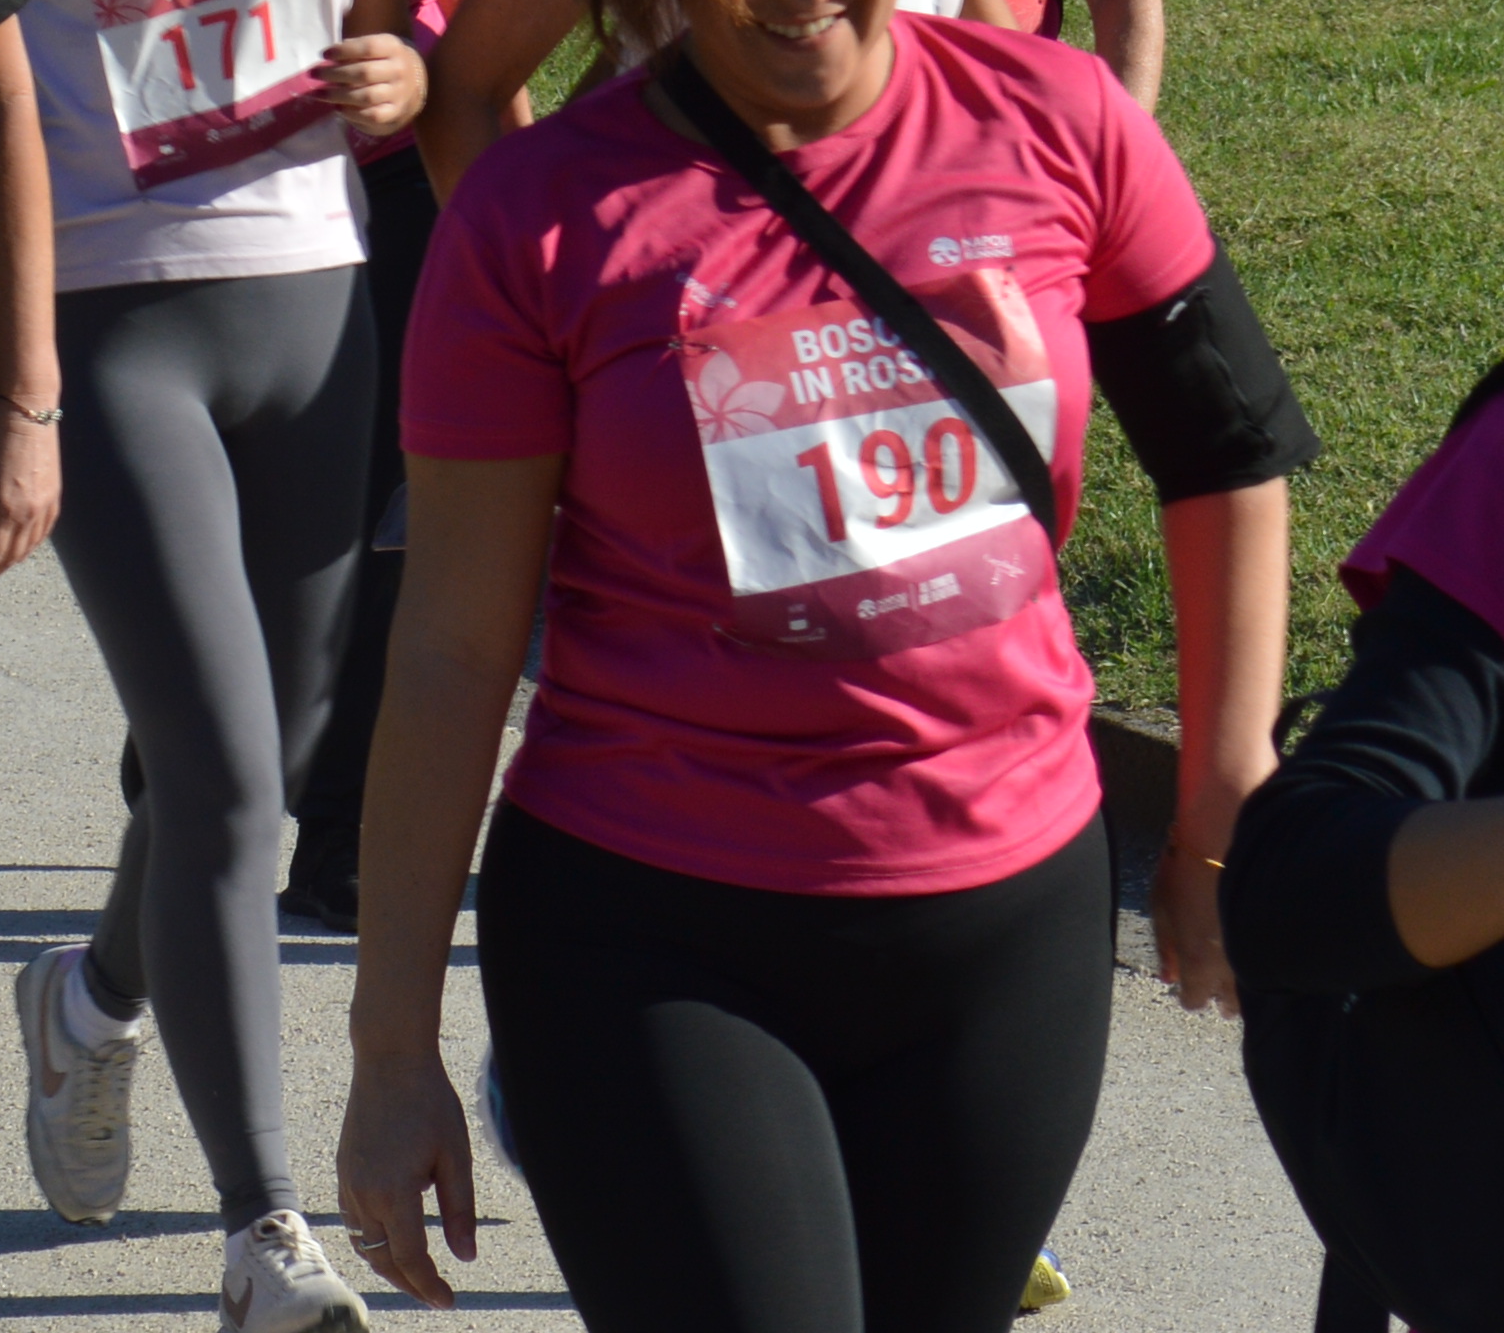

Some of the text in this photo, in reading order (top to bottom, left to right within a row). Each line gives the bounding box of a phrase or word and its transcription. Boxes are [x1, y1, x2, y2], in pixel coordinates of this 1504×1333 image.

[160, 0, 277, 91] 171
[788, 349, 932, 407] IN ROS
[797, 417, 977, 543] 190
